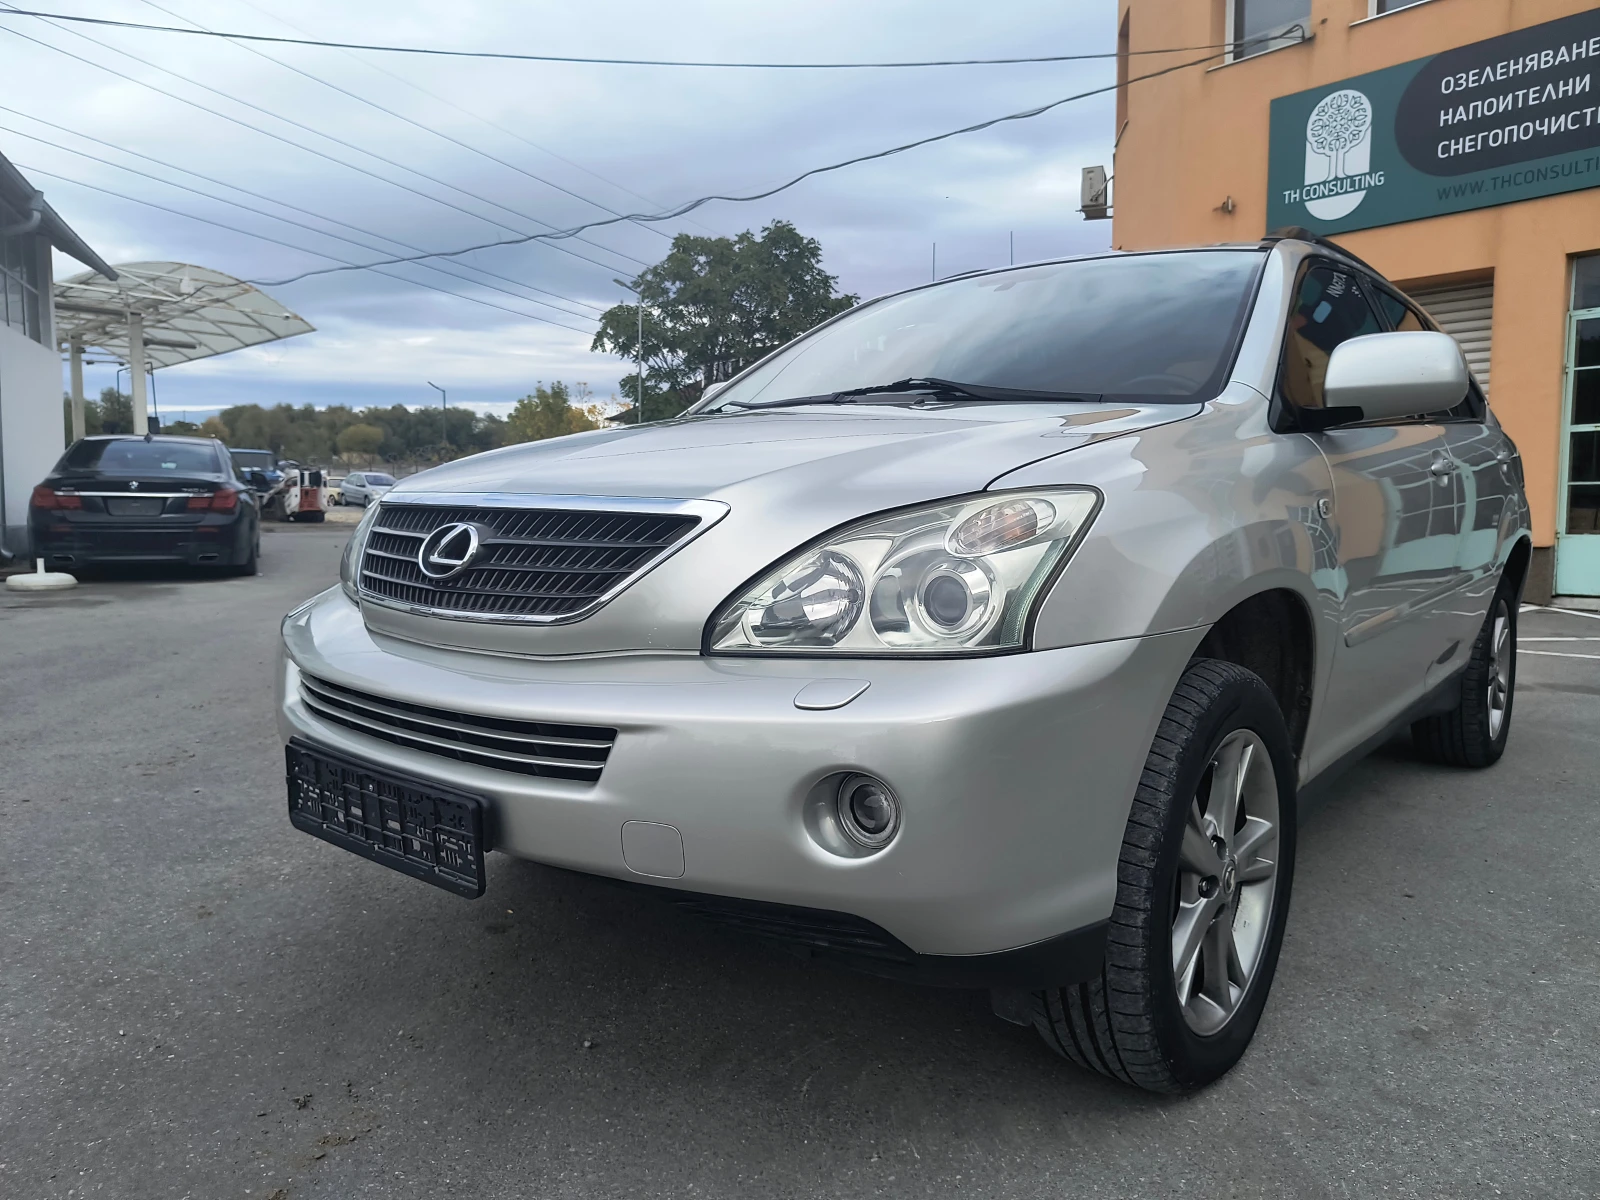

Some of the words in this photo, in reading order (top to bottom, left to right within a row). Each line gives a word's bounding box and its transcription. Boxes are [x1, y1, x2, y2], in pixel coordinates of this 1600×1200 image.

[1441, 36, 1600, 94] ОЗЕЛЕНЯВАНЕ
[1439, 73, 1591, 127] НАПОИТЕЛНИ
[1437, 106, 1600, 159] СНЕГОПОЧИСТ
[1283, 189, 1300, 204] TH
[1302, 171, 1385, 200] CONSULTING
